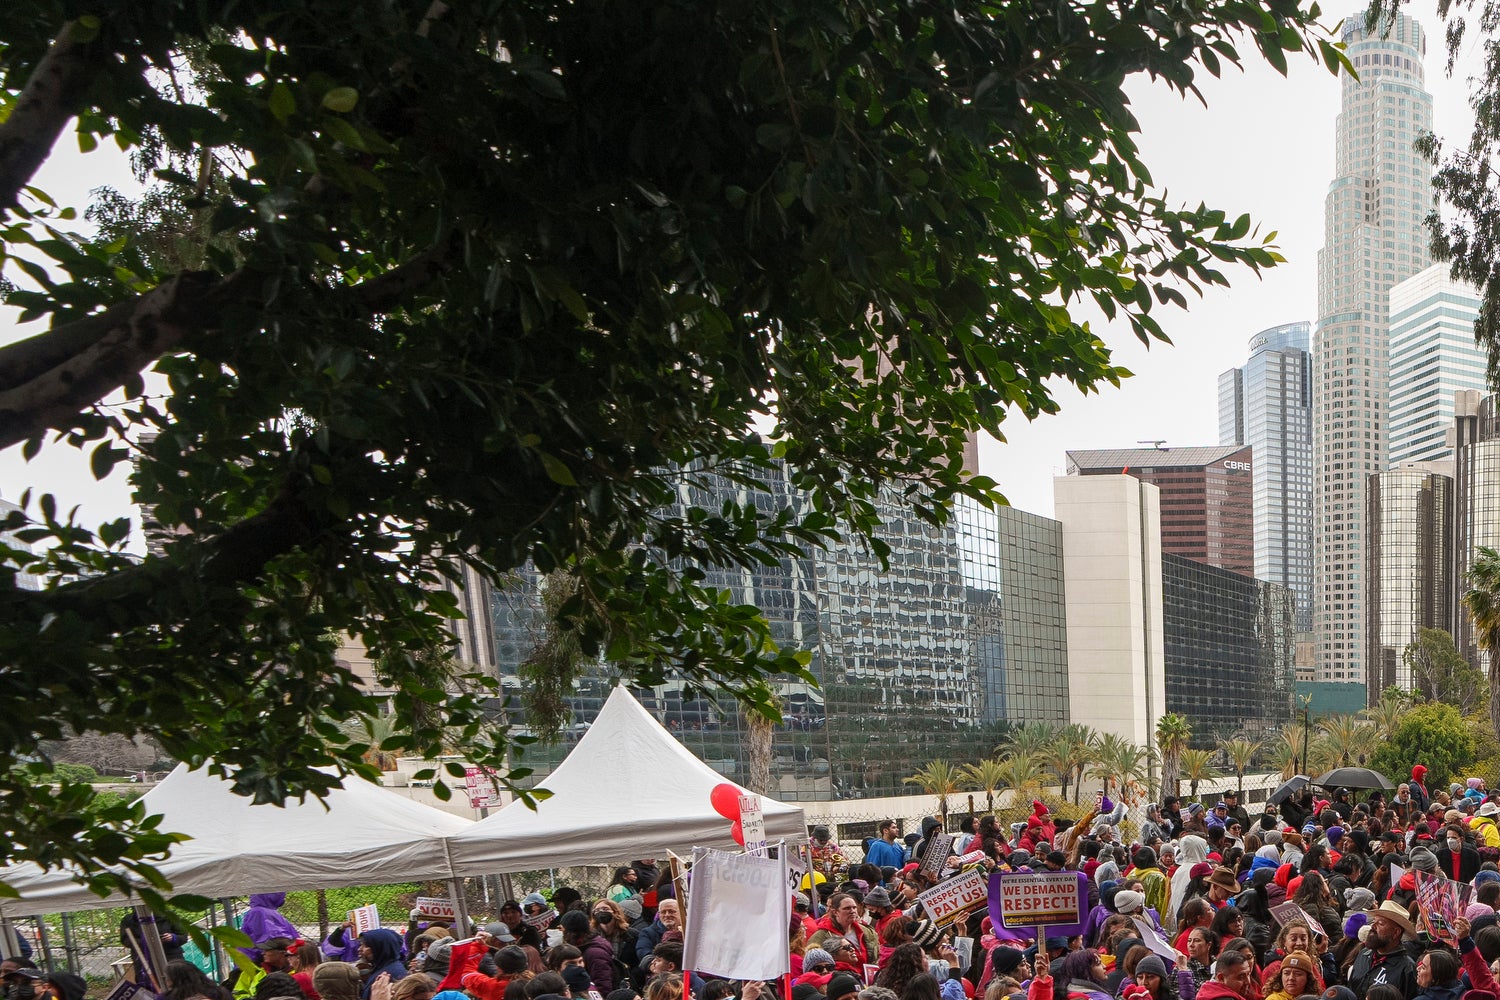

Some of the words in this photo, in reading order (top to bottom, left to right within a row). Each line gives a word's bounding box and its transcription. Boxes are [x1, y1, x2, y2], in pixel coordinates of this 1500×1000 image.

[926, 884, 963, 908] RESPECT
[964, 877, 981, 889] US!
[929, 888, 940, 897] FEED
[941, 882, 952, 891] OUR
[953, 870, 979, 886] STUDENTS
[1003, 886, 1020, 896] WE
[1023, 884, 1075, 895] DEMAND
[420, 905, 454, 916] NOW
[933, 898, 960, 917] PAY
[961, 886, 985, 904] US!
[1004, 896, 1077, 911] RESPECT!
